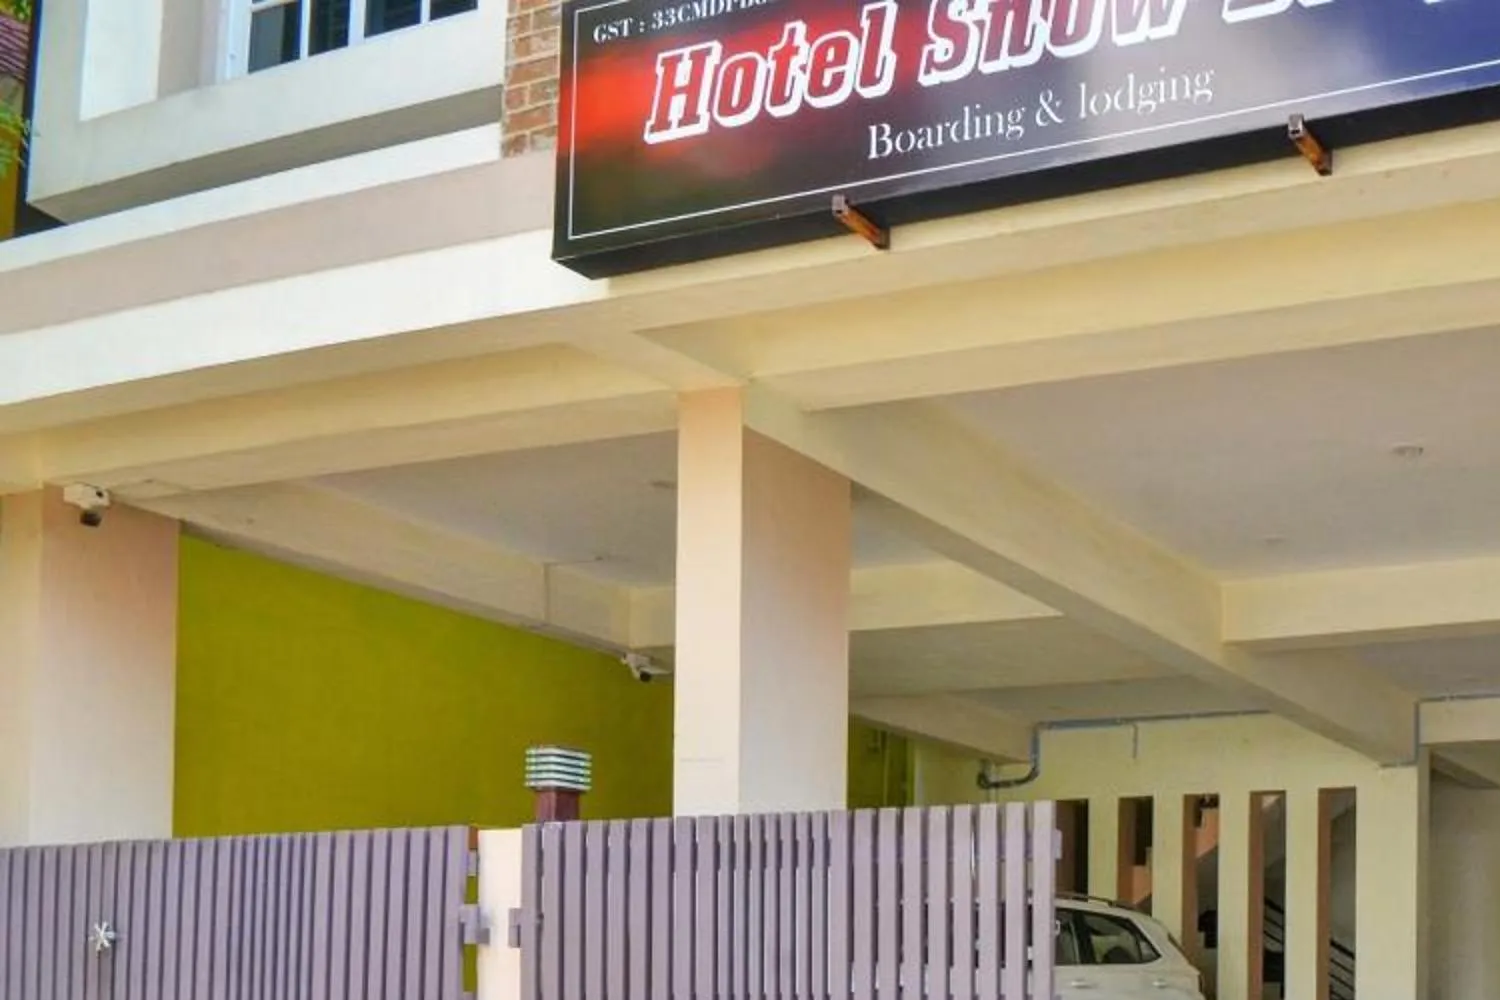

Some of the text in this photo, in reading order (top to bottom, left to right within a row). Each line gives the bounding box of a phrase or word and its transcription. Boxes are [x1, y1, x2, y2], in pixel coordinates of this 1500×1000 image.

[592, 18, 633, 43] GST
[643, 0, 1188, 144] Hotel Snow
[868, 65, 1215, 159] Boarding & lodging
